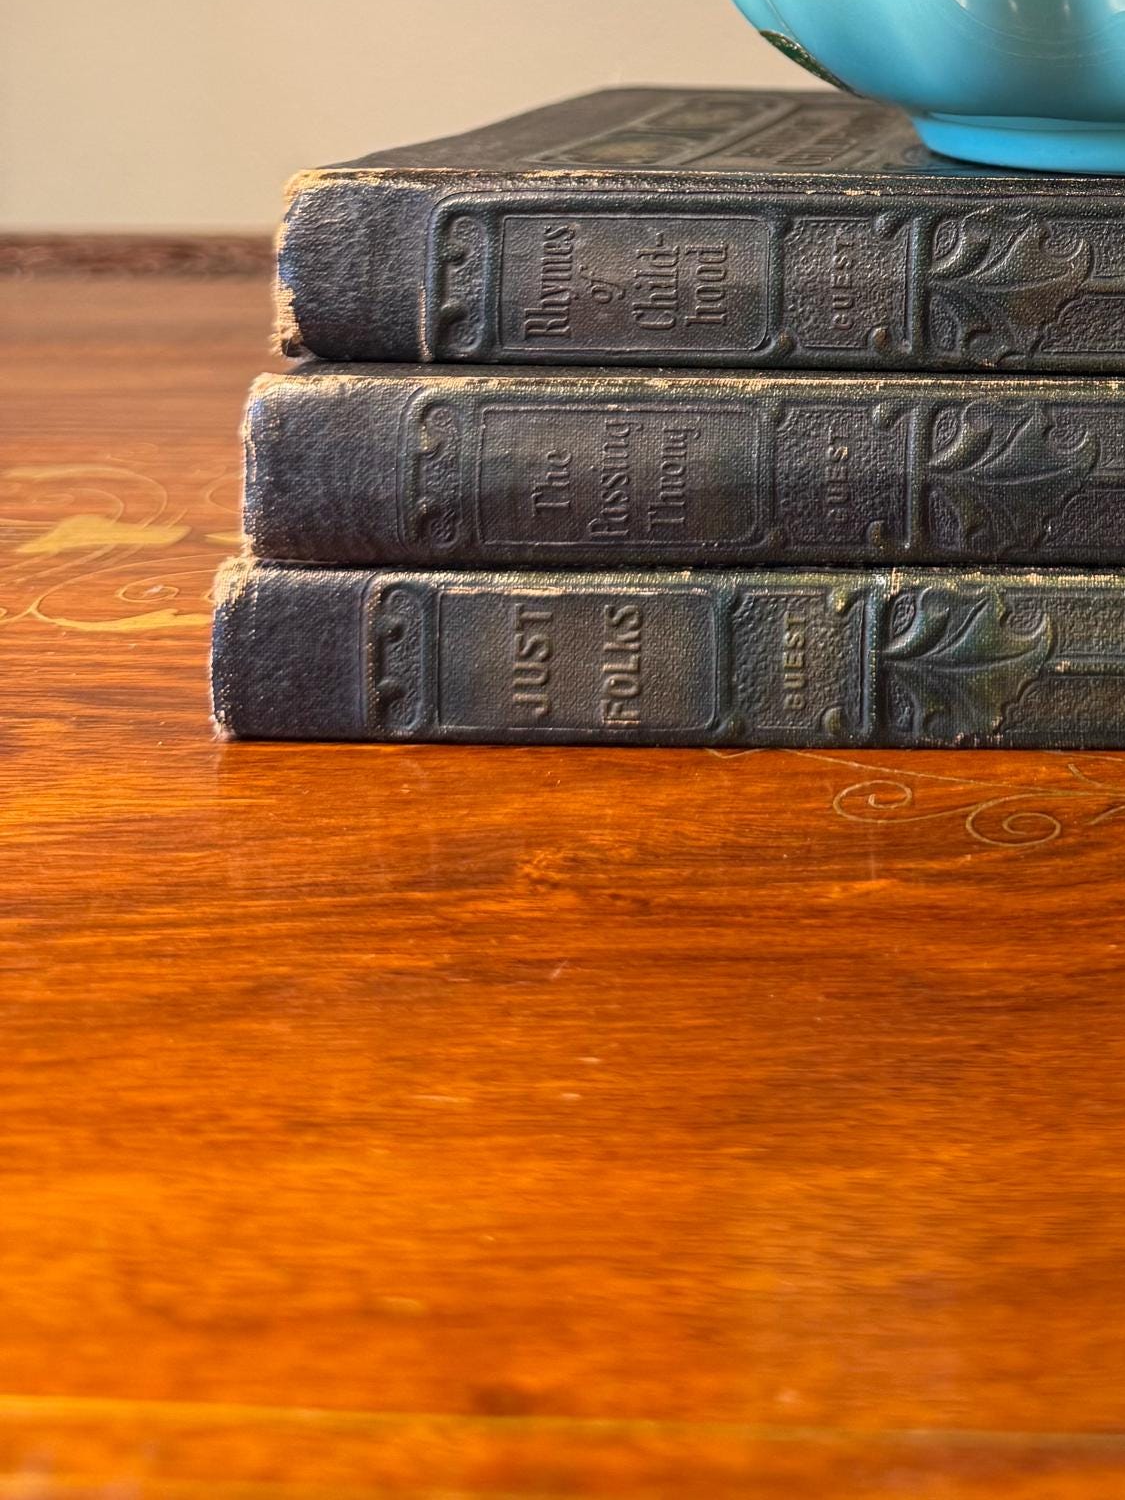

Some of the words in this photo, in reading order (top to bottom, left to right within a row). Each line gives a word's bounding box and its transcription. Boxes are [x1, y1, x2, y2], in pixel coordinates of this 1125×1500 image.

[524, 225, 576, 340] Rhymes
[578, 263, 625, 304] of
[631, 232, 681, 330] Child-
[685, 241, 728, 326] hood
[531, 449, 573, 516] The
[587, 417, 644, 538] Passing
[648, 420, 701, 532] Throng
[512, 603, 553, 717] JUST
[602, 603, 641, 729] FOLKS
